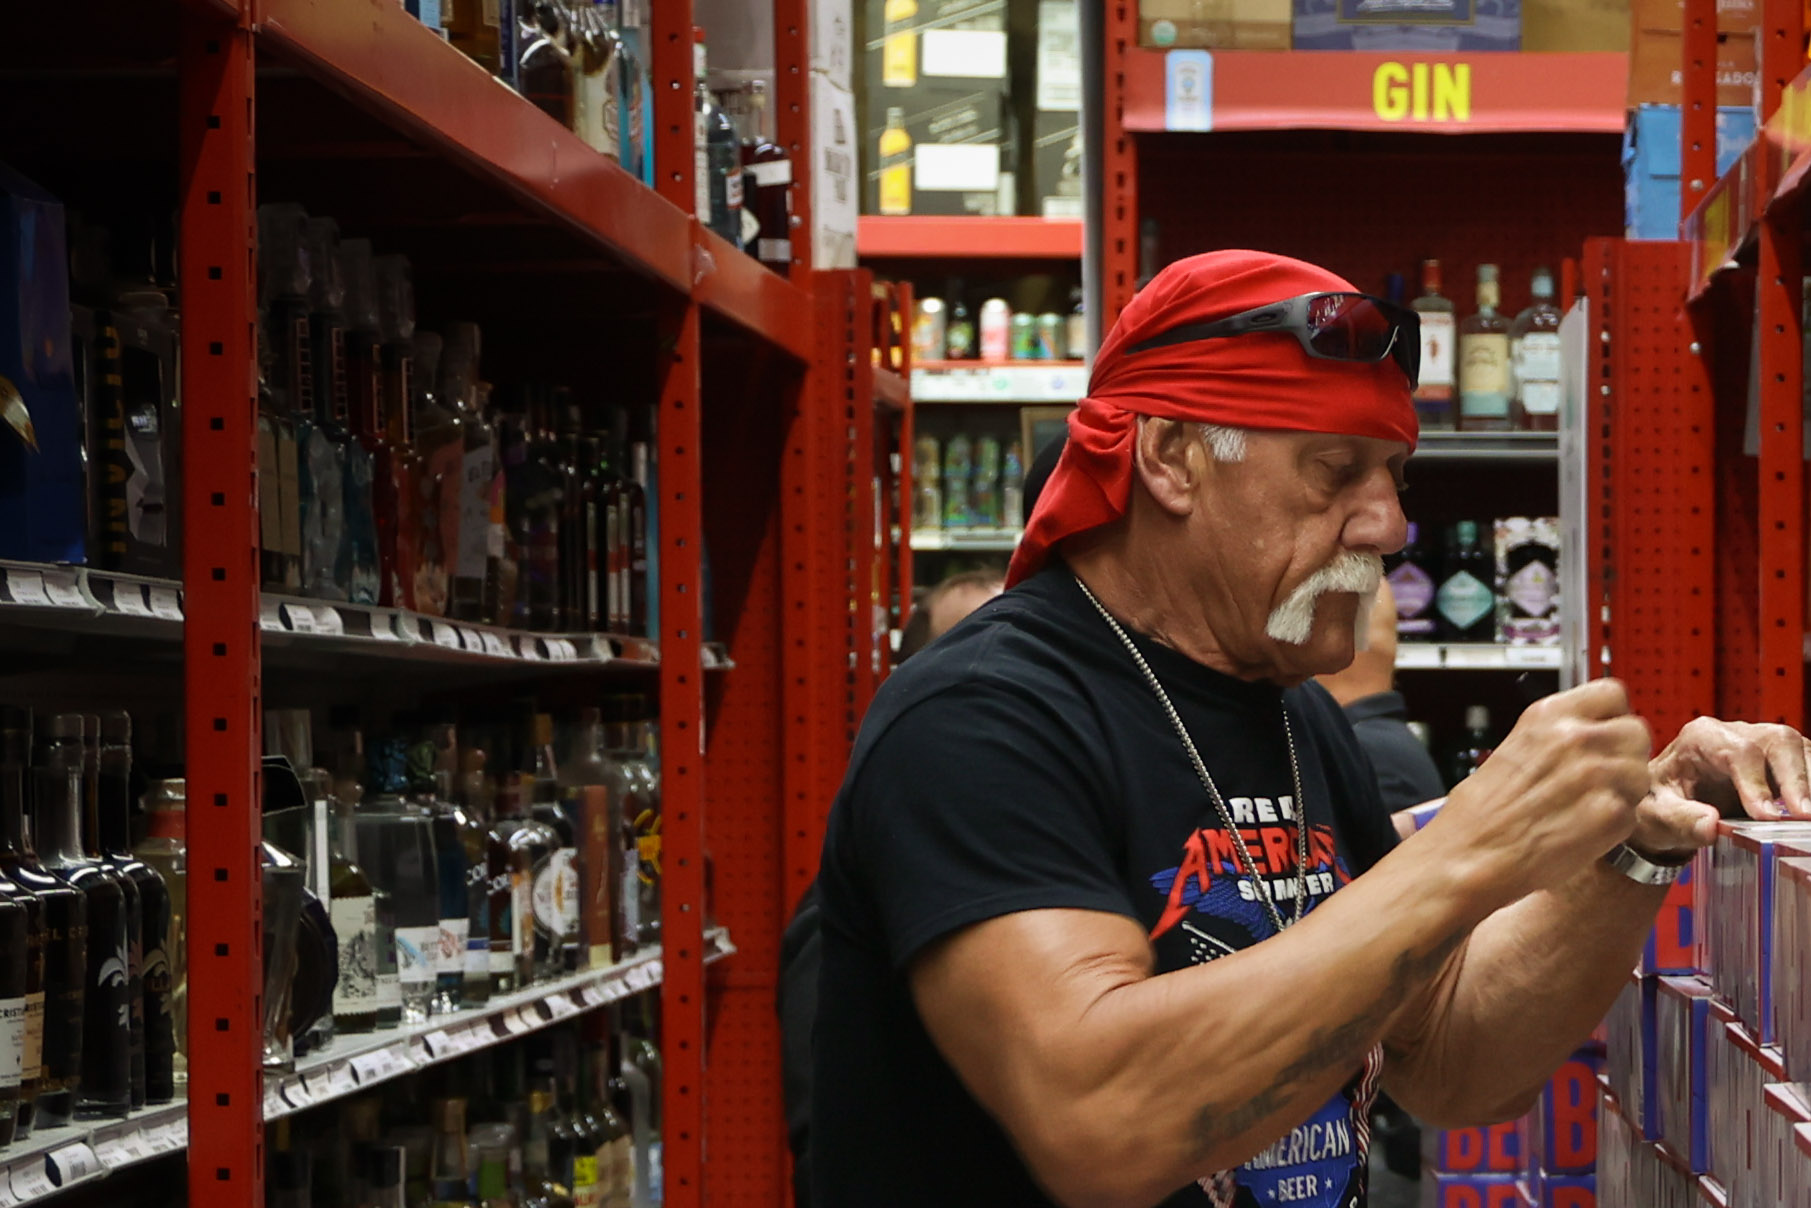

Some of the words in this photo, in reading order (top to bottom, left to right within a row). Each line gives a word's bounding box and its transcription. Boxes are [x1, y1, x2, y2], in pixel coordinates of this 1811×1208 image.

[1373, 61, 1472, 122] GIN
[1228, 795, 1297, 823] REA
[1244, 1118, 1351, 1171] MERICAN
[1278, 1174, 1318, 1202] BEER
